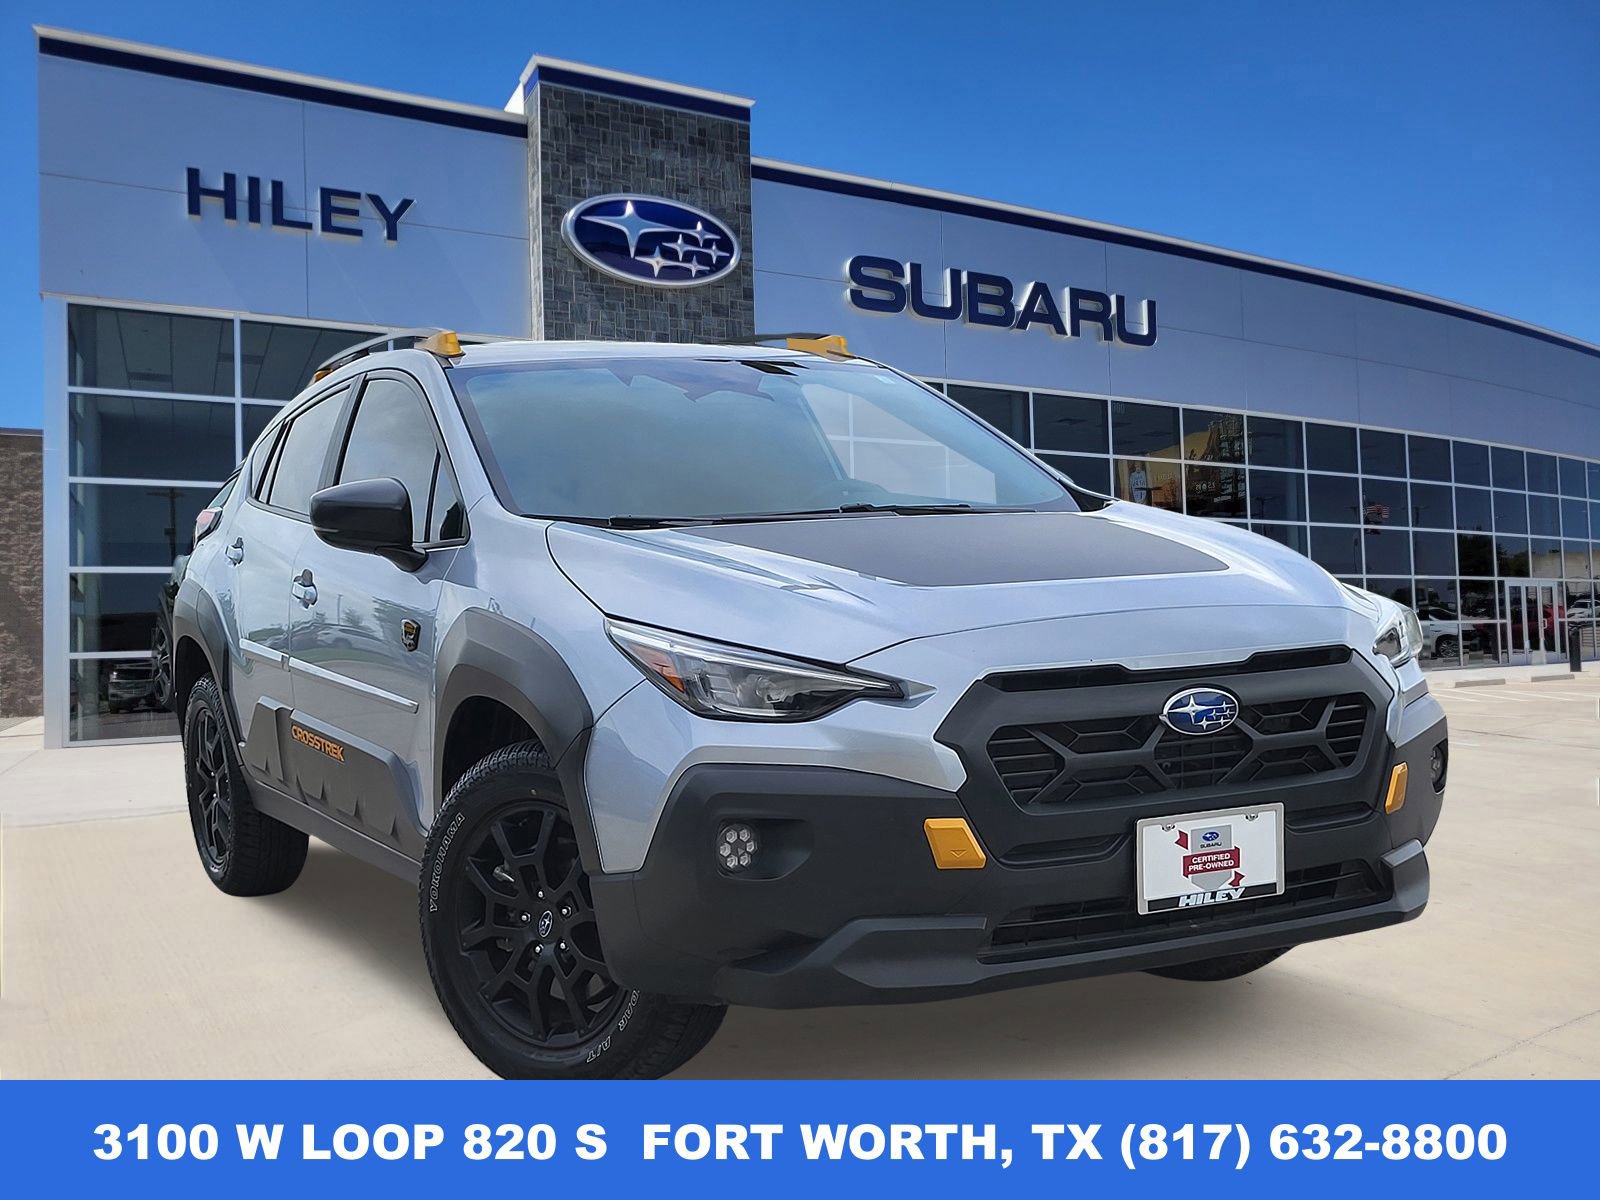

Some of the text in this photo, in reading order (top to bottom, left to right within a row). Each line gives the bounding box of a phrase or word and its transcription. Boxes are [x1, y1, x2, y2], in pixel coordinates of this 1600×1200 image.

[187, 167, 416, 242] HILEY
[847, 255, 1158, 347] SUBARU
[290, 724, 346, 763] CROSSTREK
[428, 811, 466, 914] YOKOHAMA
[1188, 860, 1235, 872] PRE-OWNED
[1191, 852, 1231, 864] CERTIFIED
[1178, 887, 1246, 908] HILEY
[586, 1035, 611, 1063] A/T
